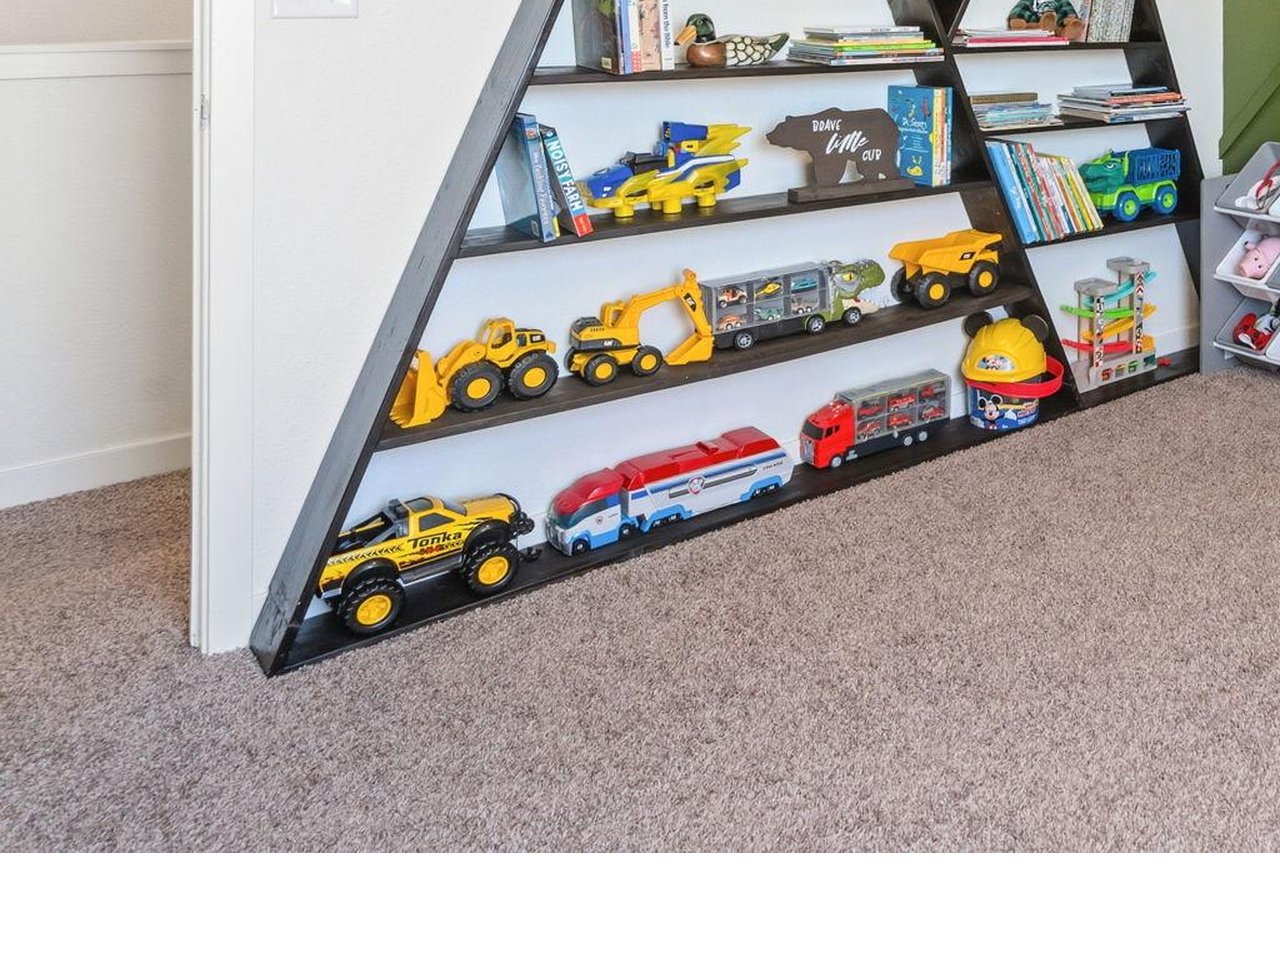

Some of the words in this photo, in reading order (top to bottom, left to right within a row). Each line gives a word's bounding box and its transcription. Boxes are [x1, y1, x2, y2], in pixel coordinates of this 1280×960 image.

[812, 119, 842, 132] BRAVE
[825, 130, 869, 154] little
[548, 141, 572, 180] NOISY
[407, 531, 462, 549] Tonka
